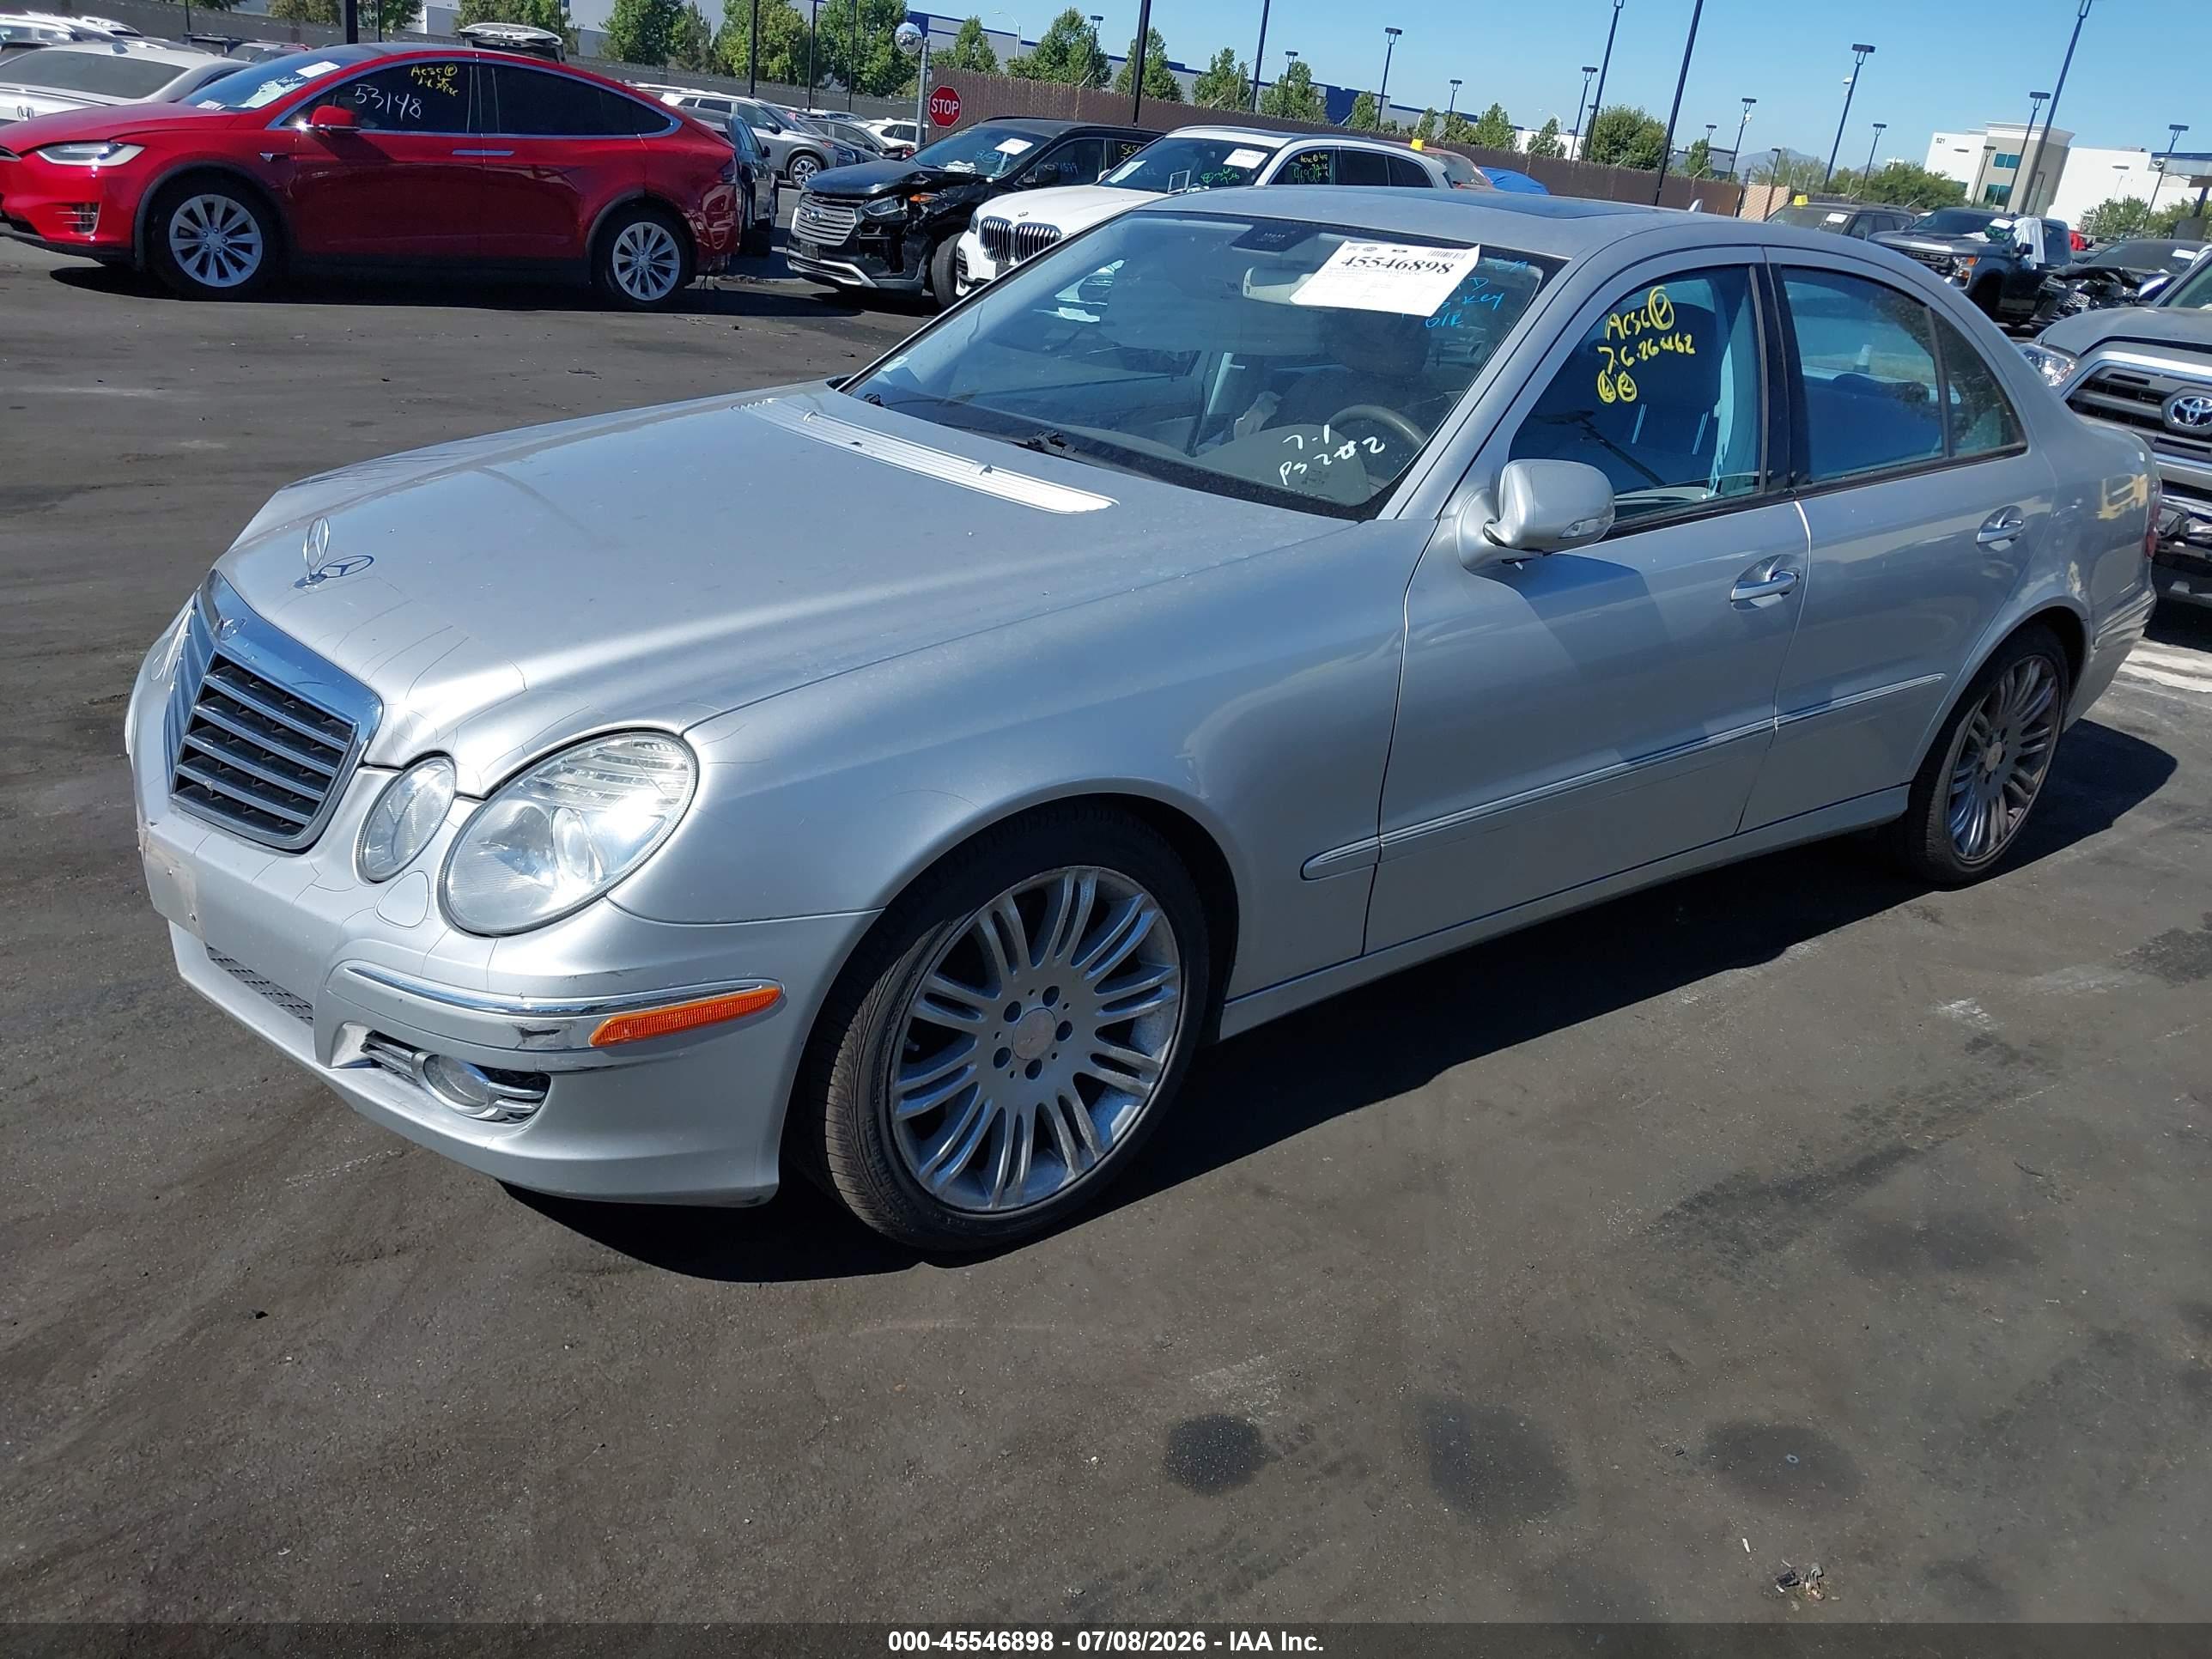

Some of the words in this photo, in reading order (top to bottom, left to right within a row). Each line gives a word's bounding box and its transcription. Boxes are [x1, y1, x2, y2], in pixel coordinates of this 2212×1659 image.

[355, 83, 422, 121] 53148
[931, 98, 959, 115] STOP
[1340, 255, 1455, 276] 45546898
